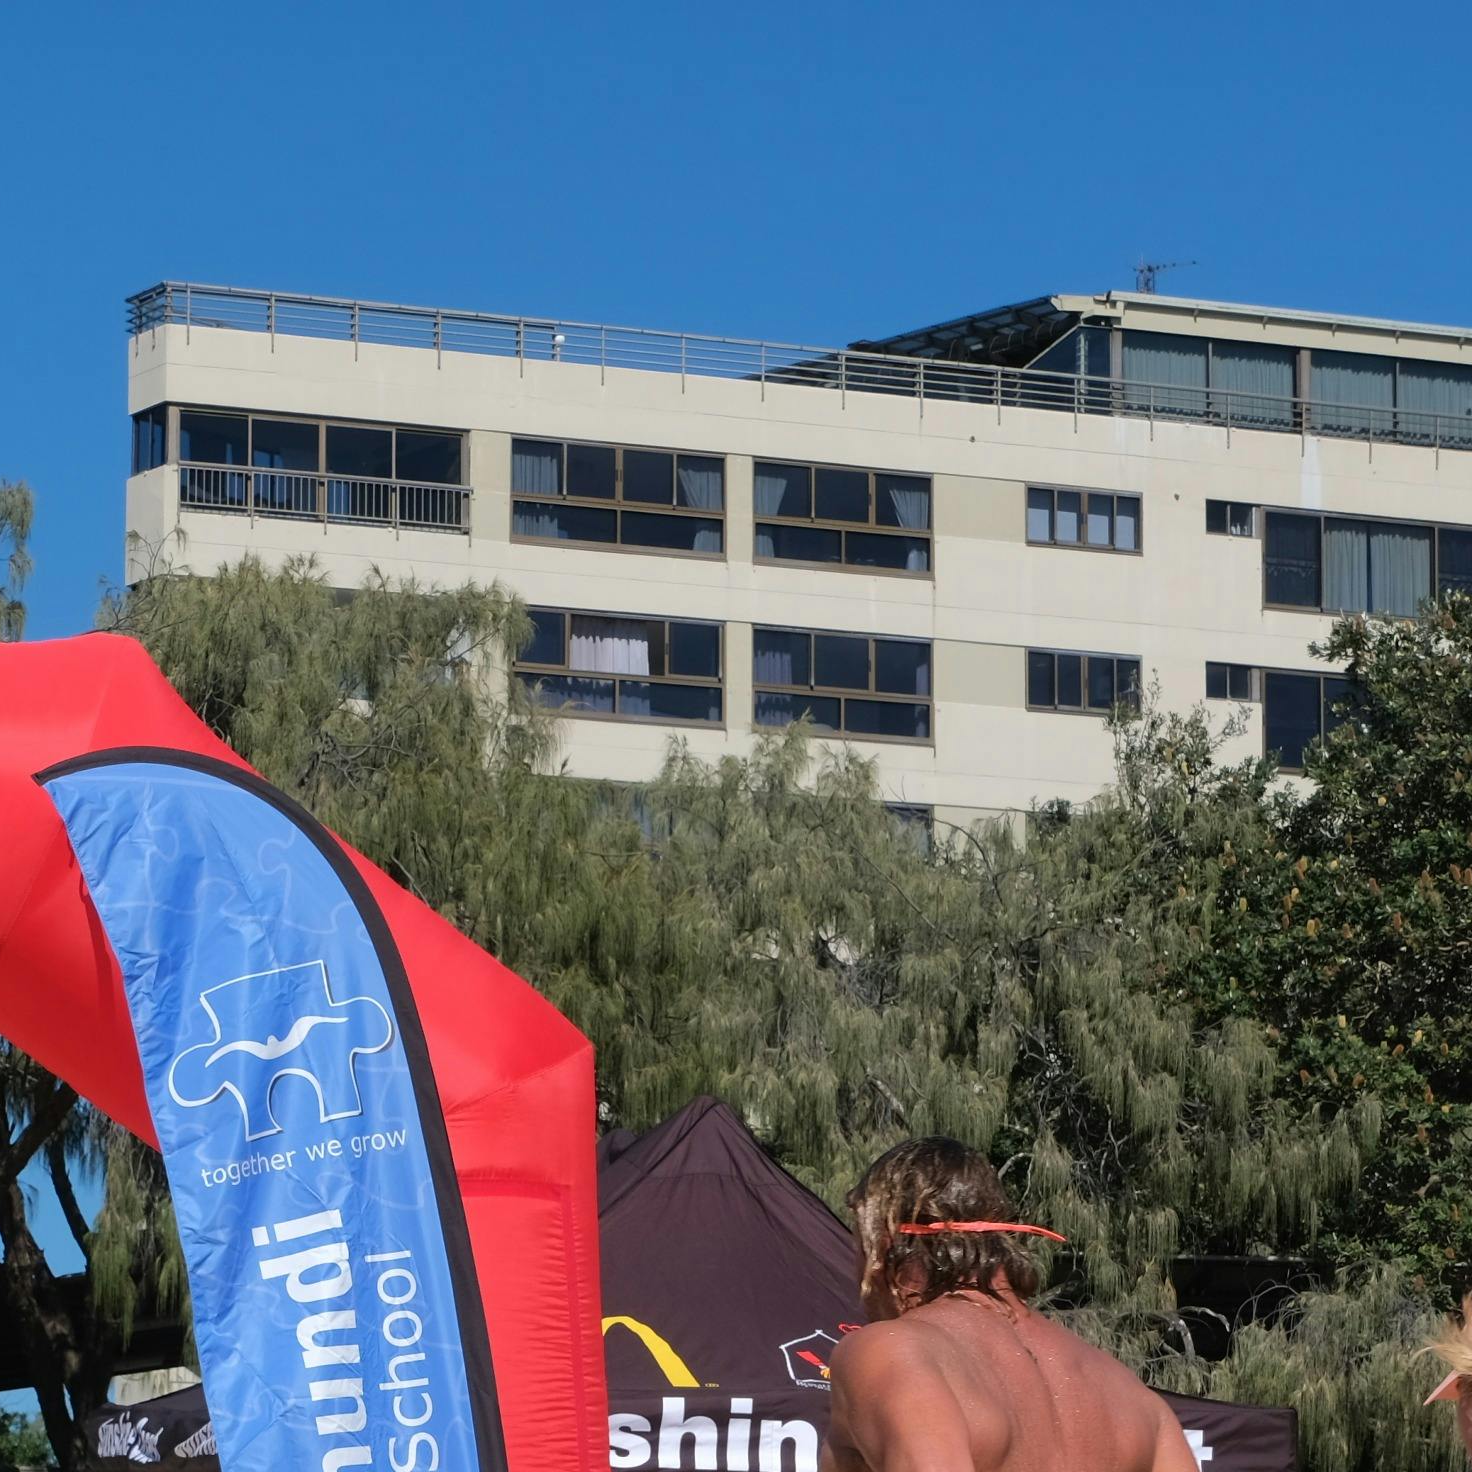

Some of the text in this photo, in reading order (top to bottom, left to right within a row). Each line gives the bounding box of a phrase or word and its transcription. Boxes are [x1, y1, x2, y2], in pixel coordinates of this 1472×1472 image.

[201, 1129, 407, 1188] together we grow
